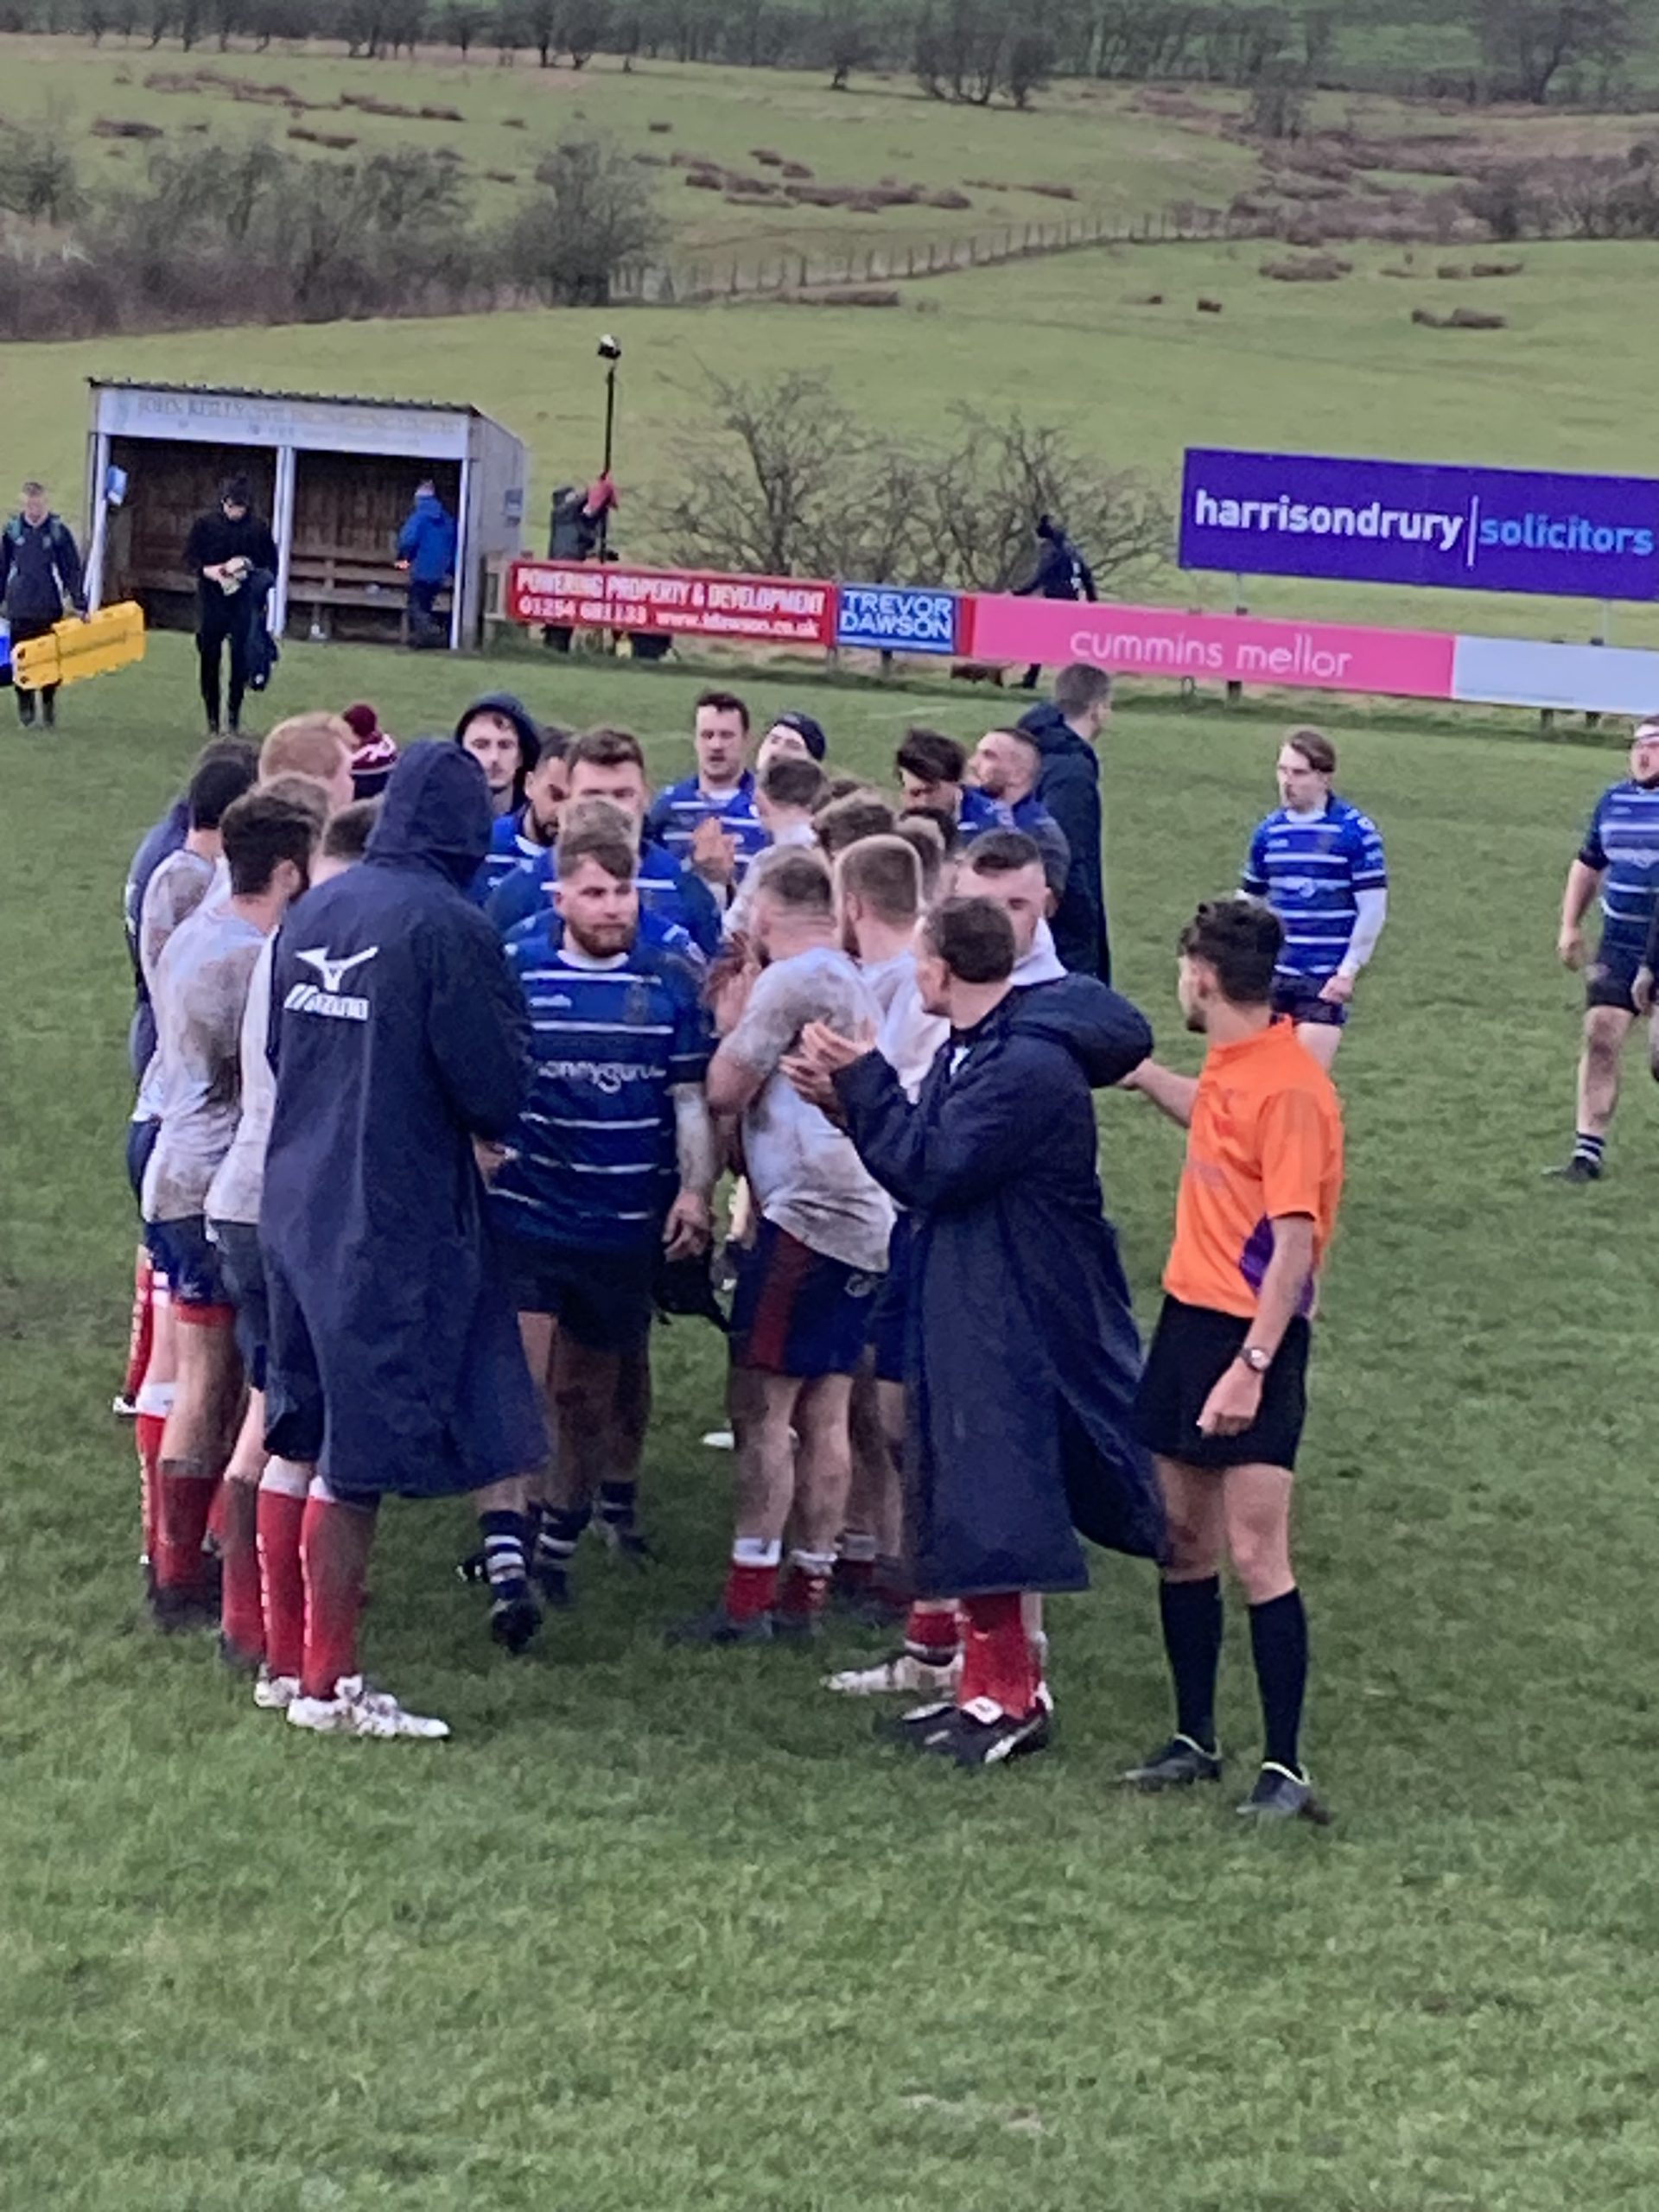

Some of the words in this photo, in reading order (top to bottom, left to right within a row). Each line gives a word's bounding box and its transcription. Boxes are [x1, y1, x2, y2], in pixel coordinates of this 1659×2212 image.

[1196, 489, 1464, 551] harrisondrury
[1478, 513, 1655, 556] solicitors
[517, 567, 604, 598] POWERING
[607, 575, 690, 607] PROPERTY
[708, 583, 825, 616] DEVELOPMENT
[843, 591, 953, 616] TREVOR
[840, 610, 951, 639] DAWSON
[1070, 631, 1223, 668] cummins
[1236, 633, 1353, 677] mellor
